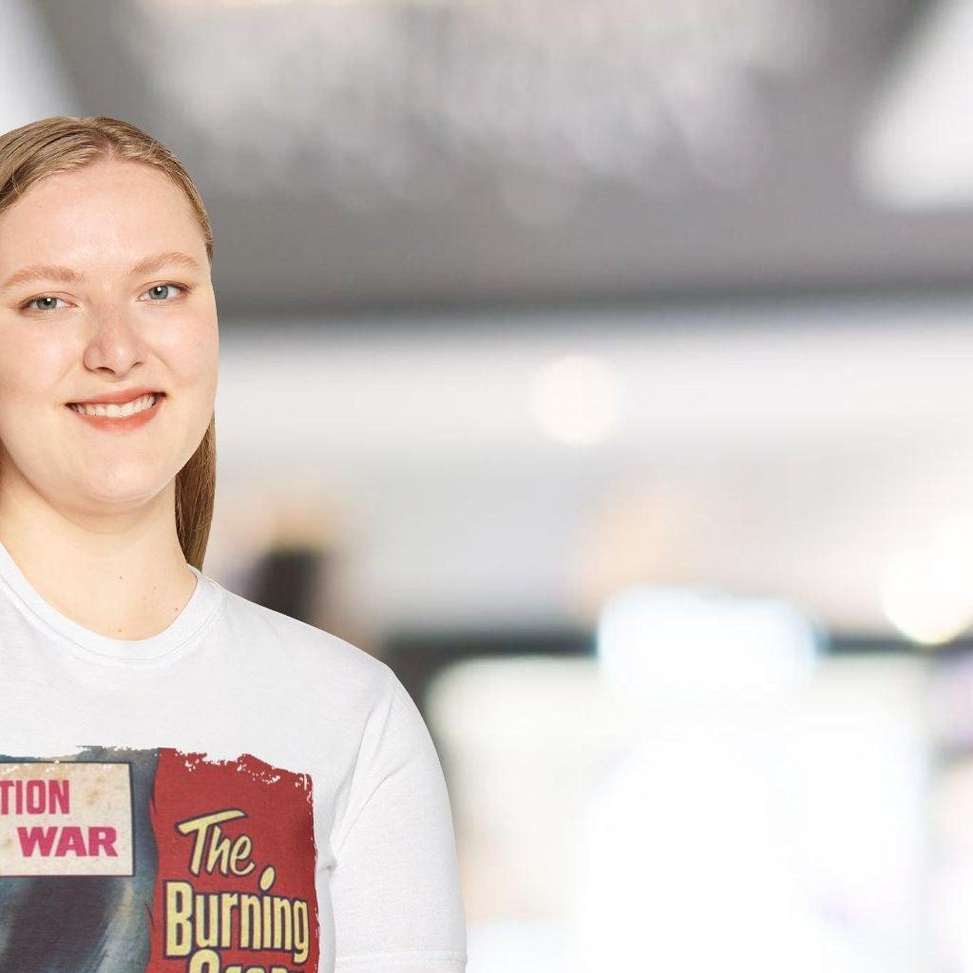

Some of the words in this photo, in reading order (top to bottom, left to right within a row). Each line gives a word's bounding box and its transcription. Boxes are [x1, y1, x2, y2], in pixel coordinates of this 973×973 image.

[17, 826, 118, 857] WAR
[176, 808, 257, 876] The
[163, 865, 311, 965] Burning
